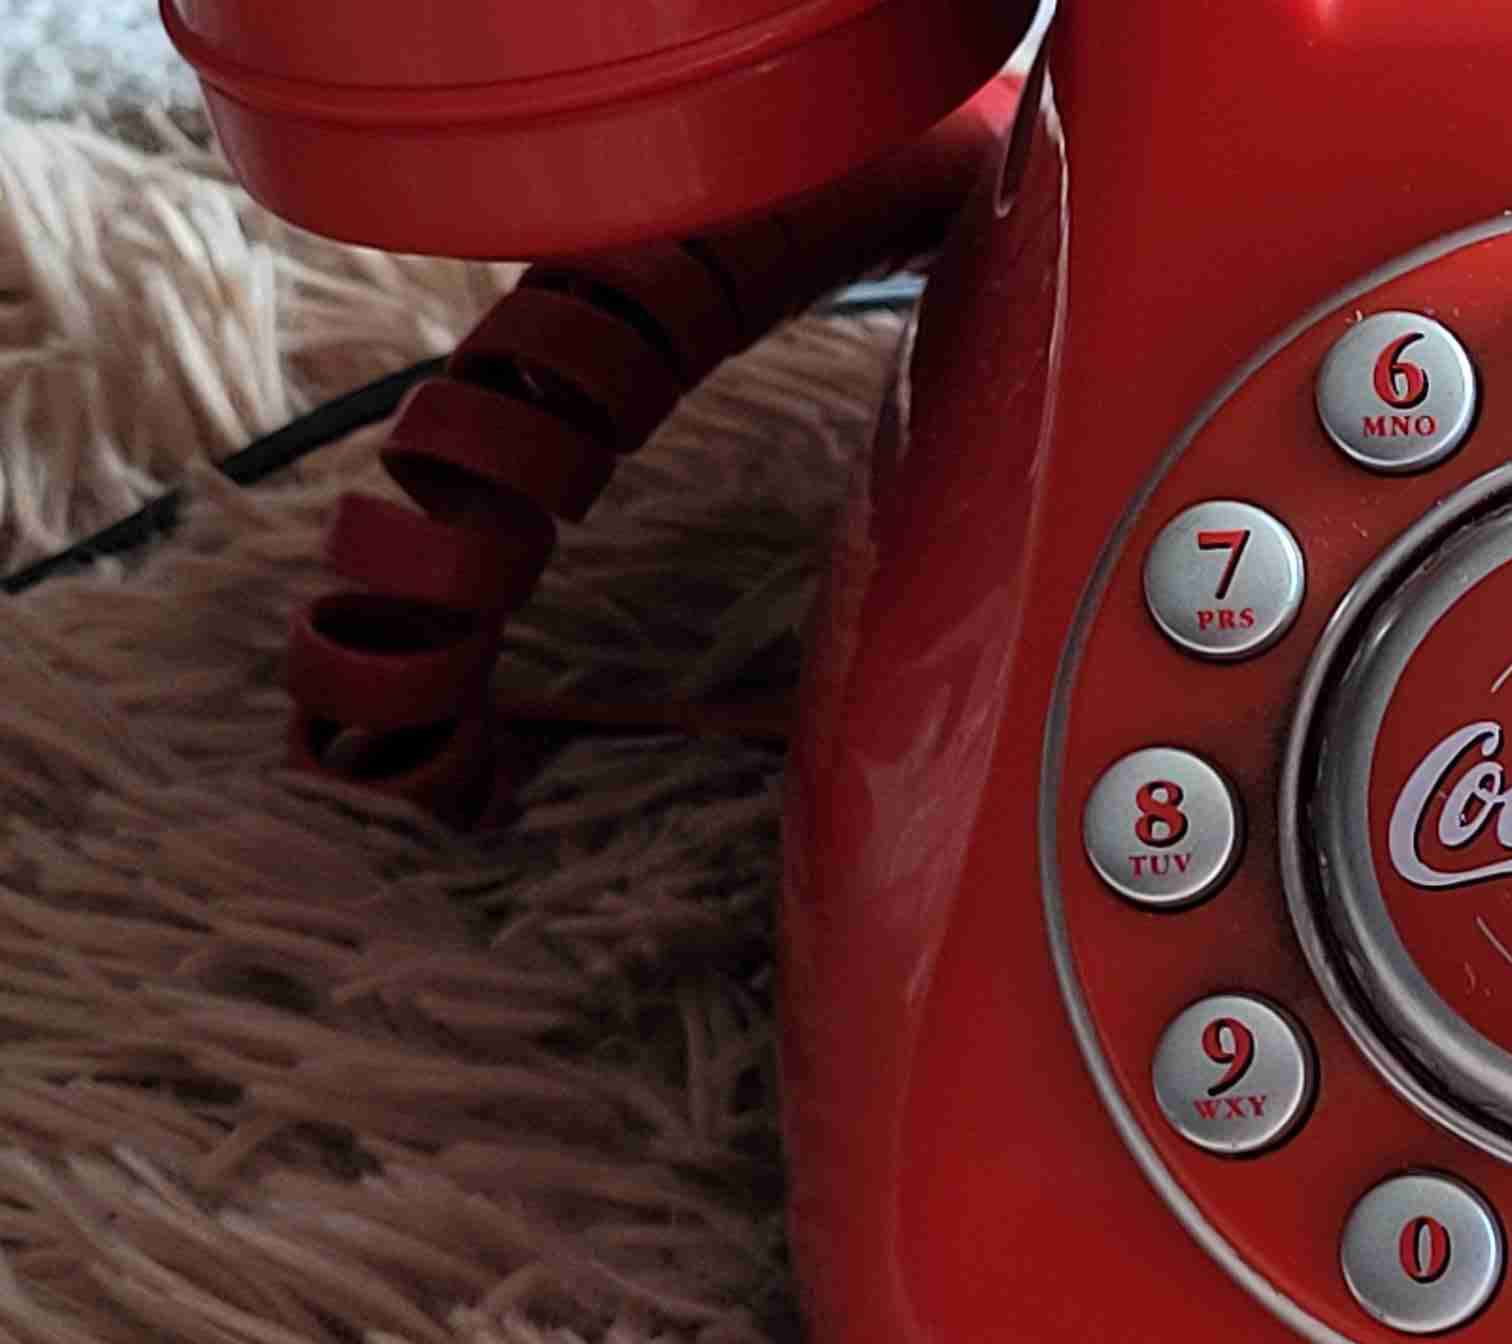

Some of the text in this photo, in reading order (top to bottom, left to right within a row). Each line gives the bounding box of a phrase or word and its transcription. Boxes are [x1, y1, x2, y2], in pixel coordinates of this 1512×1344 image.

[1371, 332, 1428, 410] 6
[1362, 415, 1437, 439] MNO
[1197, 528, 1251, 600] 7
[1197, 608, 1255, 631] PRS
[1134, 780, 1187, 848] 8
[1129, 853, 1193, 879] TUV
[1199, 1016, 1255, 1097] 9
[1193, 1095, 1267, 1121] WXY
[1398, 1215, 1451, 1284] 0
